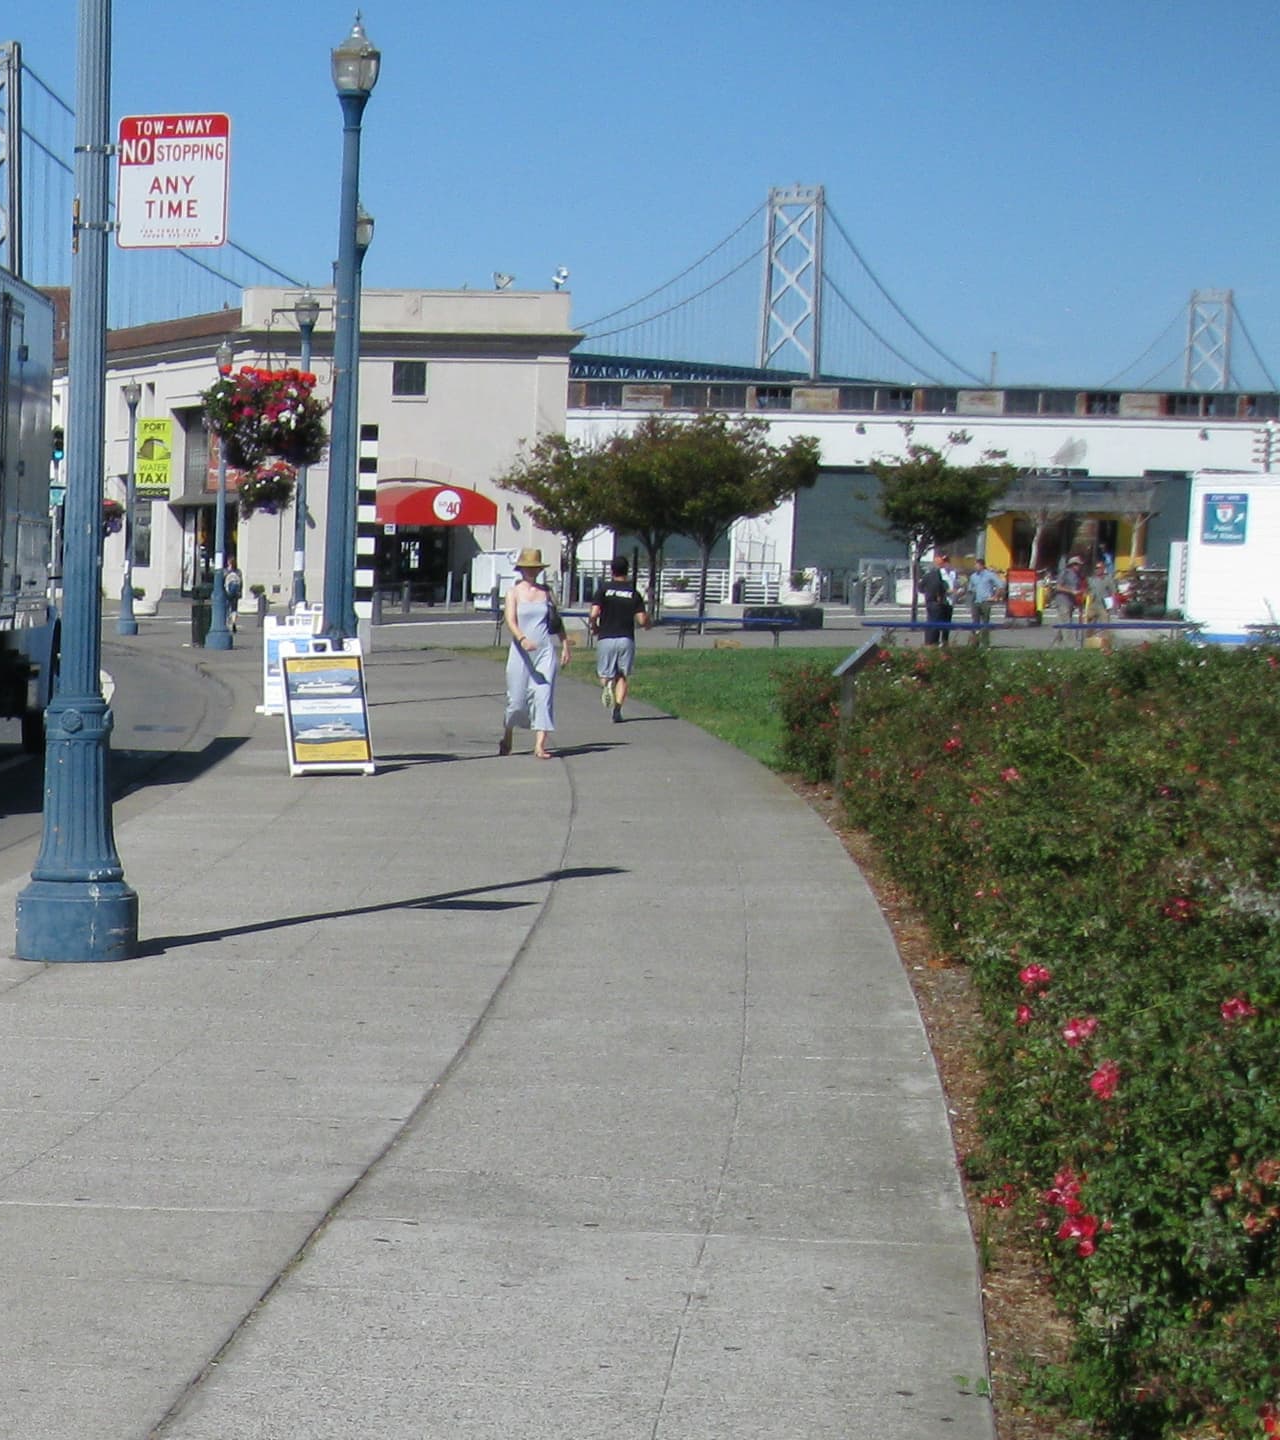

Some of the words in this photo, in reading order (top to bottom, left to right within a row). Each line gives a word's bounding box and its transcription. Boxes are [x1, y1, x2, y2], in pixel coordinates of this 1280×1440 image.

[135, 119, 213, 136] TOW-AWAY
[122, 139, 152, 163] NO
[156, 143, 225, 162] STOPPING
[148, 175, 196, 195] ANY
[144, 199, 199, 219] TIME
[143, 422, 166, 432] PORT
[139, 463, 169, 472] WATER
[138, 472, 168, 484] TAXI
